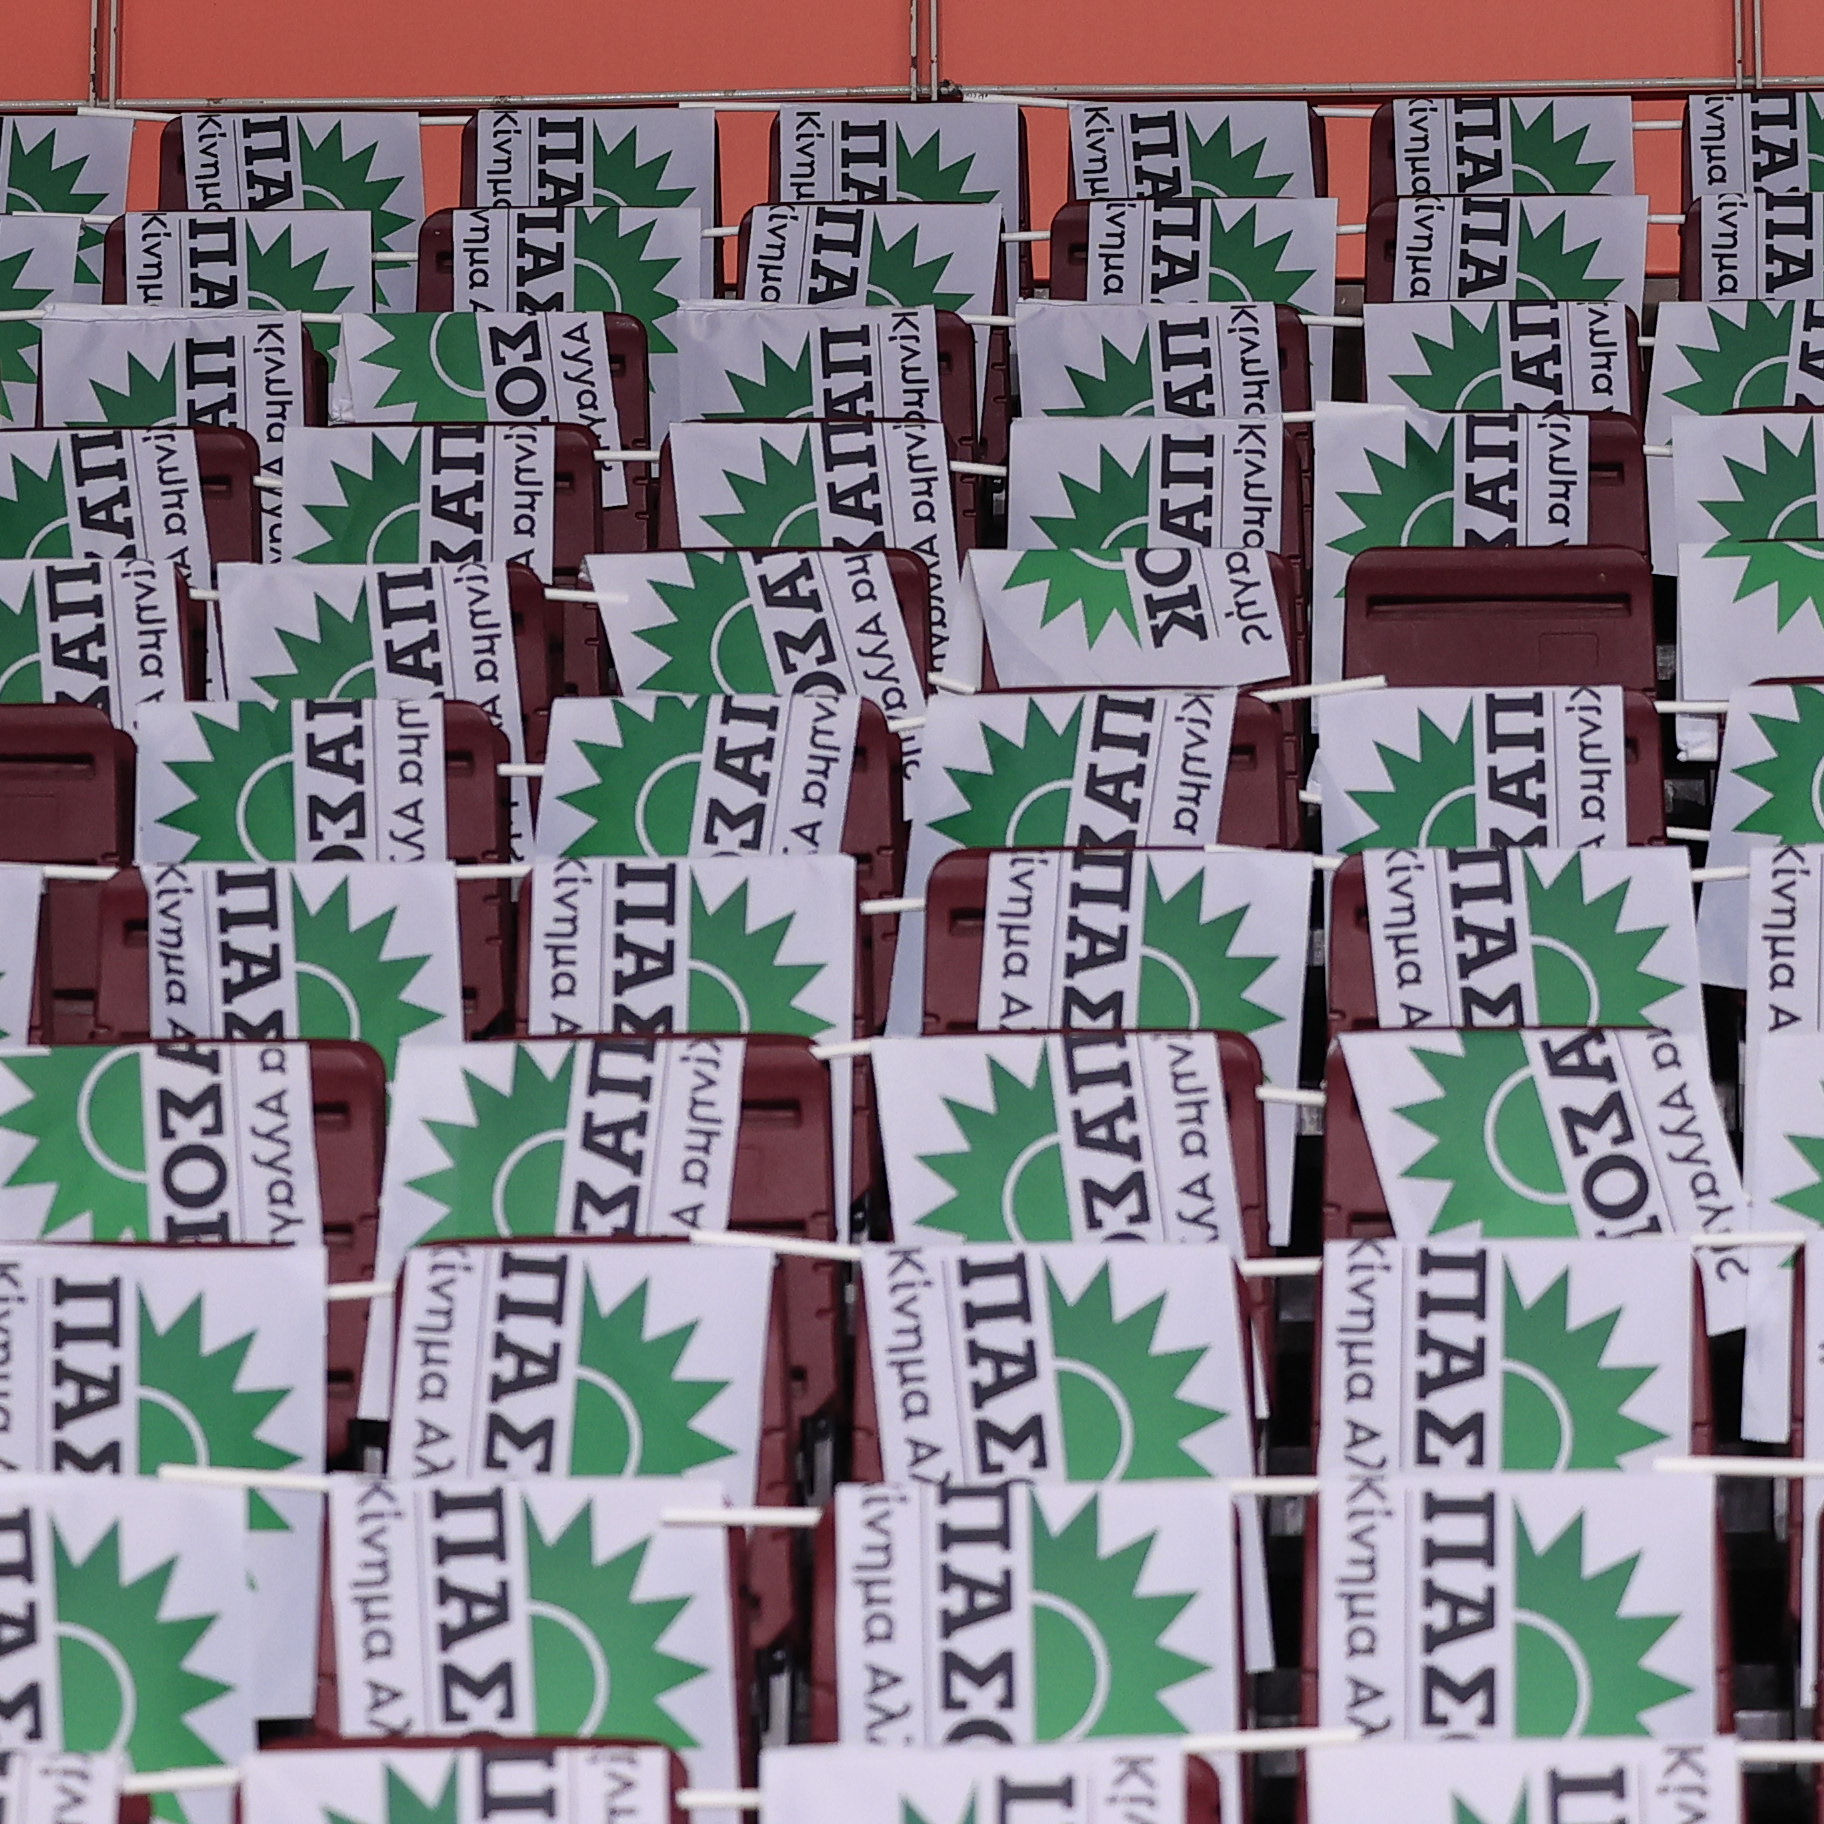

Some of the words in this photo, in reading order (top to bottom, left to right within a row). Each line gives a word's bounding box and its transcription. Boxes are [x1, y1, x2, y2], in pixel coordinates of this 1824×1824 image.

[790, 112, 820, 200] Κίνημ
[1083, 107, 1109, 196] Κίνημ
[1700, 97, 1734, 185] ίνημα
[137, 214, 171, 303] Κίνημ
[1099, 203, 1136, 295] ίνημα
[614, 863, 675, 1036] ΠΑΣ
[998, 858, 1048, 978] ίνημα
[1066, 851, 1133, 1034] ΠΑΣ
[1454, 848, 1517, 1026] ΠΑΣ
[55, 1278, 119, 1473] ΠΑΣ
[486, 1252, 567, 1472] ΠΑΣ
[886, 1247, 932, 1422] Κίνημα
[960, 1254, 1047, 1473] ΠΑΣ
[1417, 1249, 1486, 1466] ΠΑΣ
[434, 1488, 514, 1722] ΠΑΣ
[853, 1482, 907, 1645] ίνημα
[938, 1479, 1016, 1743] ΠΑΣ
[1336, 1475, 1393, 1658] Κίνημα
[1424, 1492, 1494, 1725] ΠΑΣ
